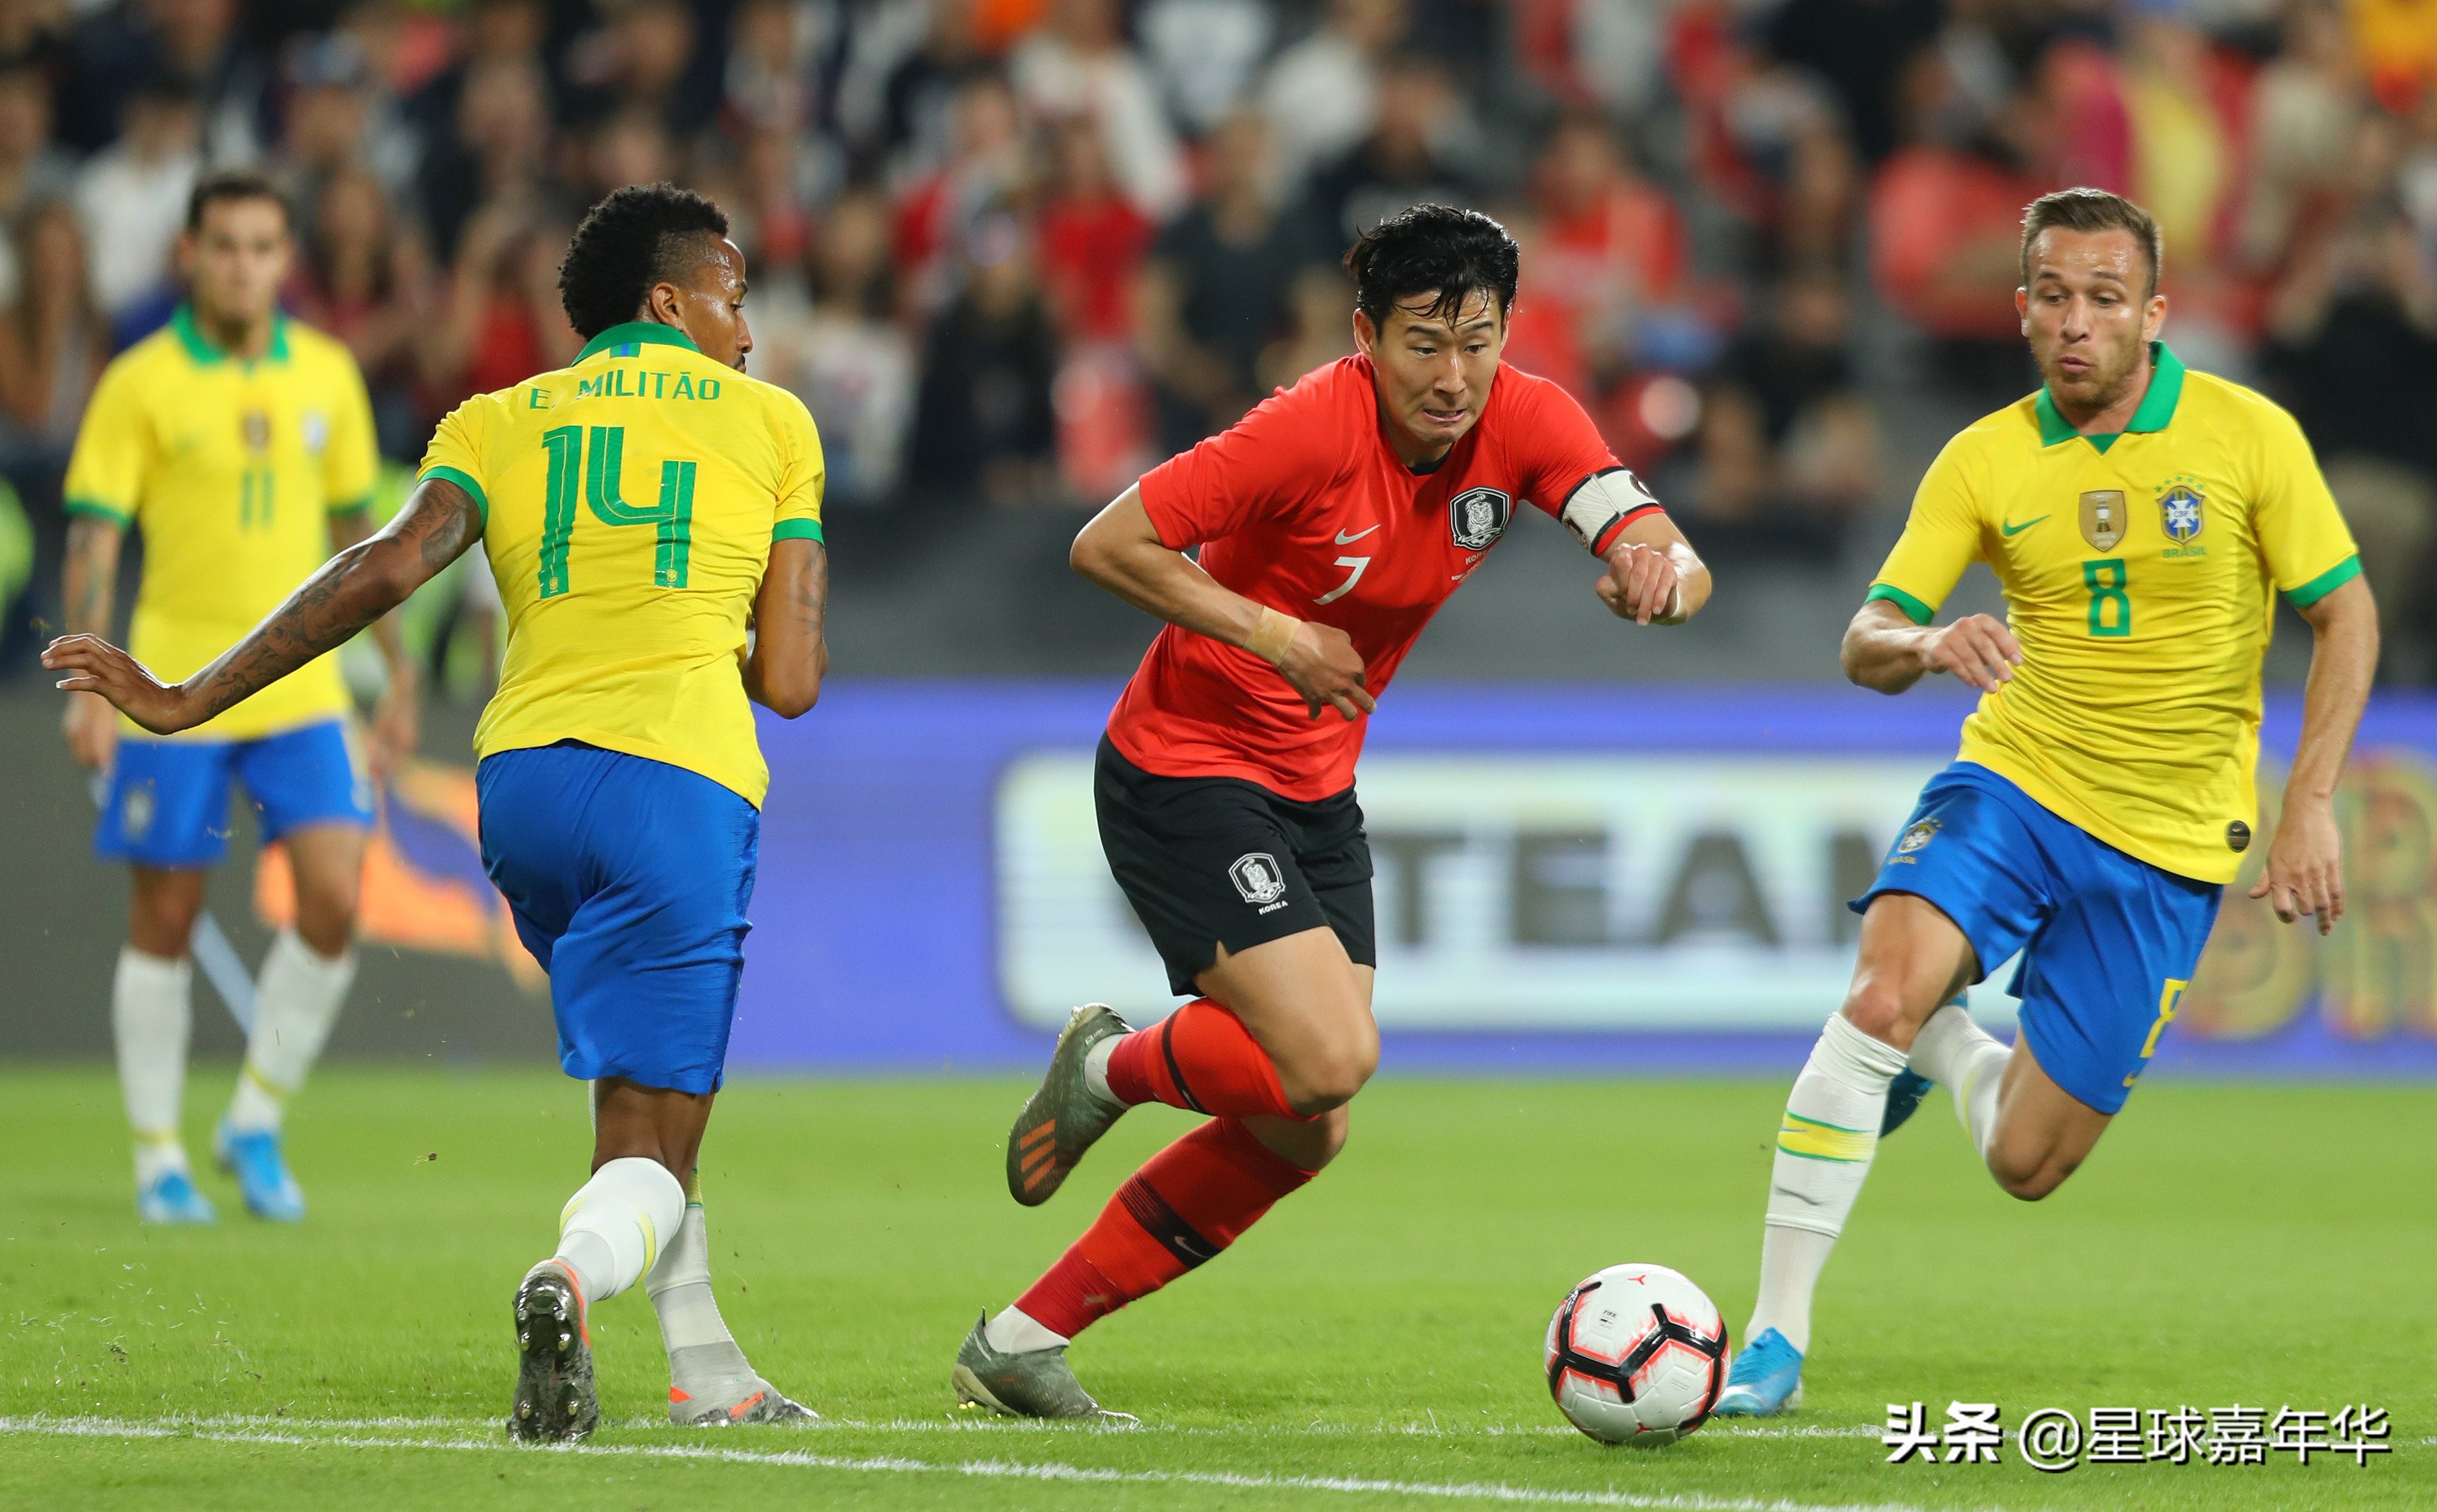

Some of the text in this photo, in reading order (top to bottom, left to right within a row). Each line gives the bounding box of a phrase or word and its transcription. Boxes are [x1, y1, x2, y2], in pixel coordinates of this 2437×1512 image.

[575, 369, 721, 401] MILITÃO
[239, 467, 275, 531] 11
[538, 425, 697, 600] 14
[2163, 547, 2207, 558] BRASIL
[1312, 556, 1371, 606] 7
[2082, 558, 2131, 637] 8
[1258, 899, 1289, 915] KOREA
